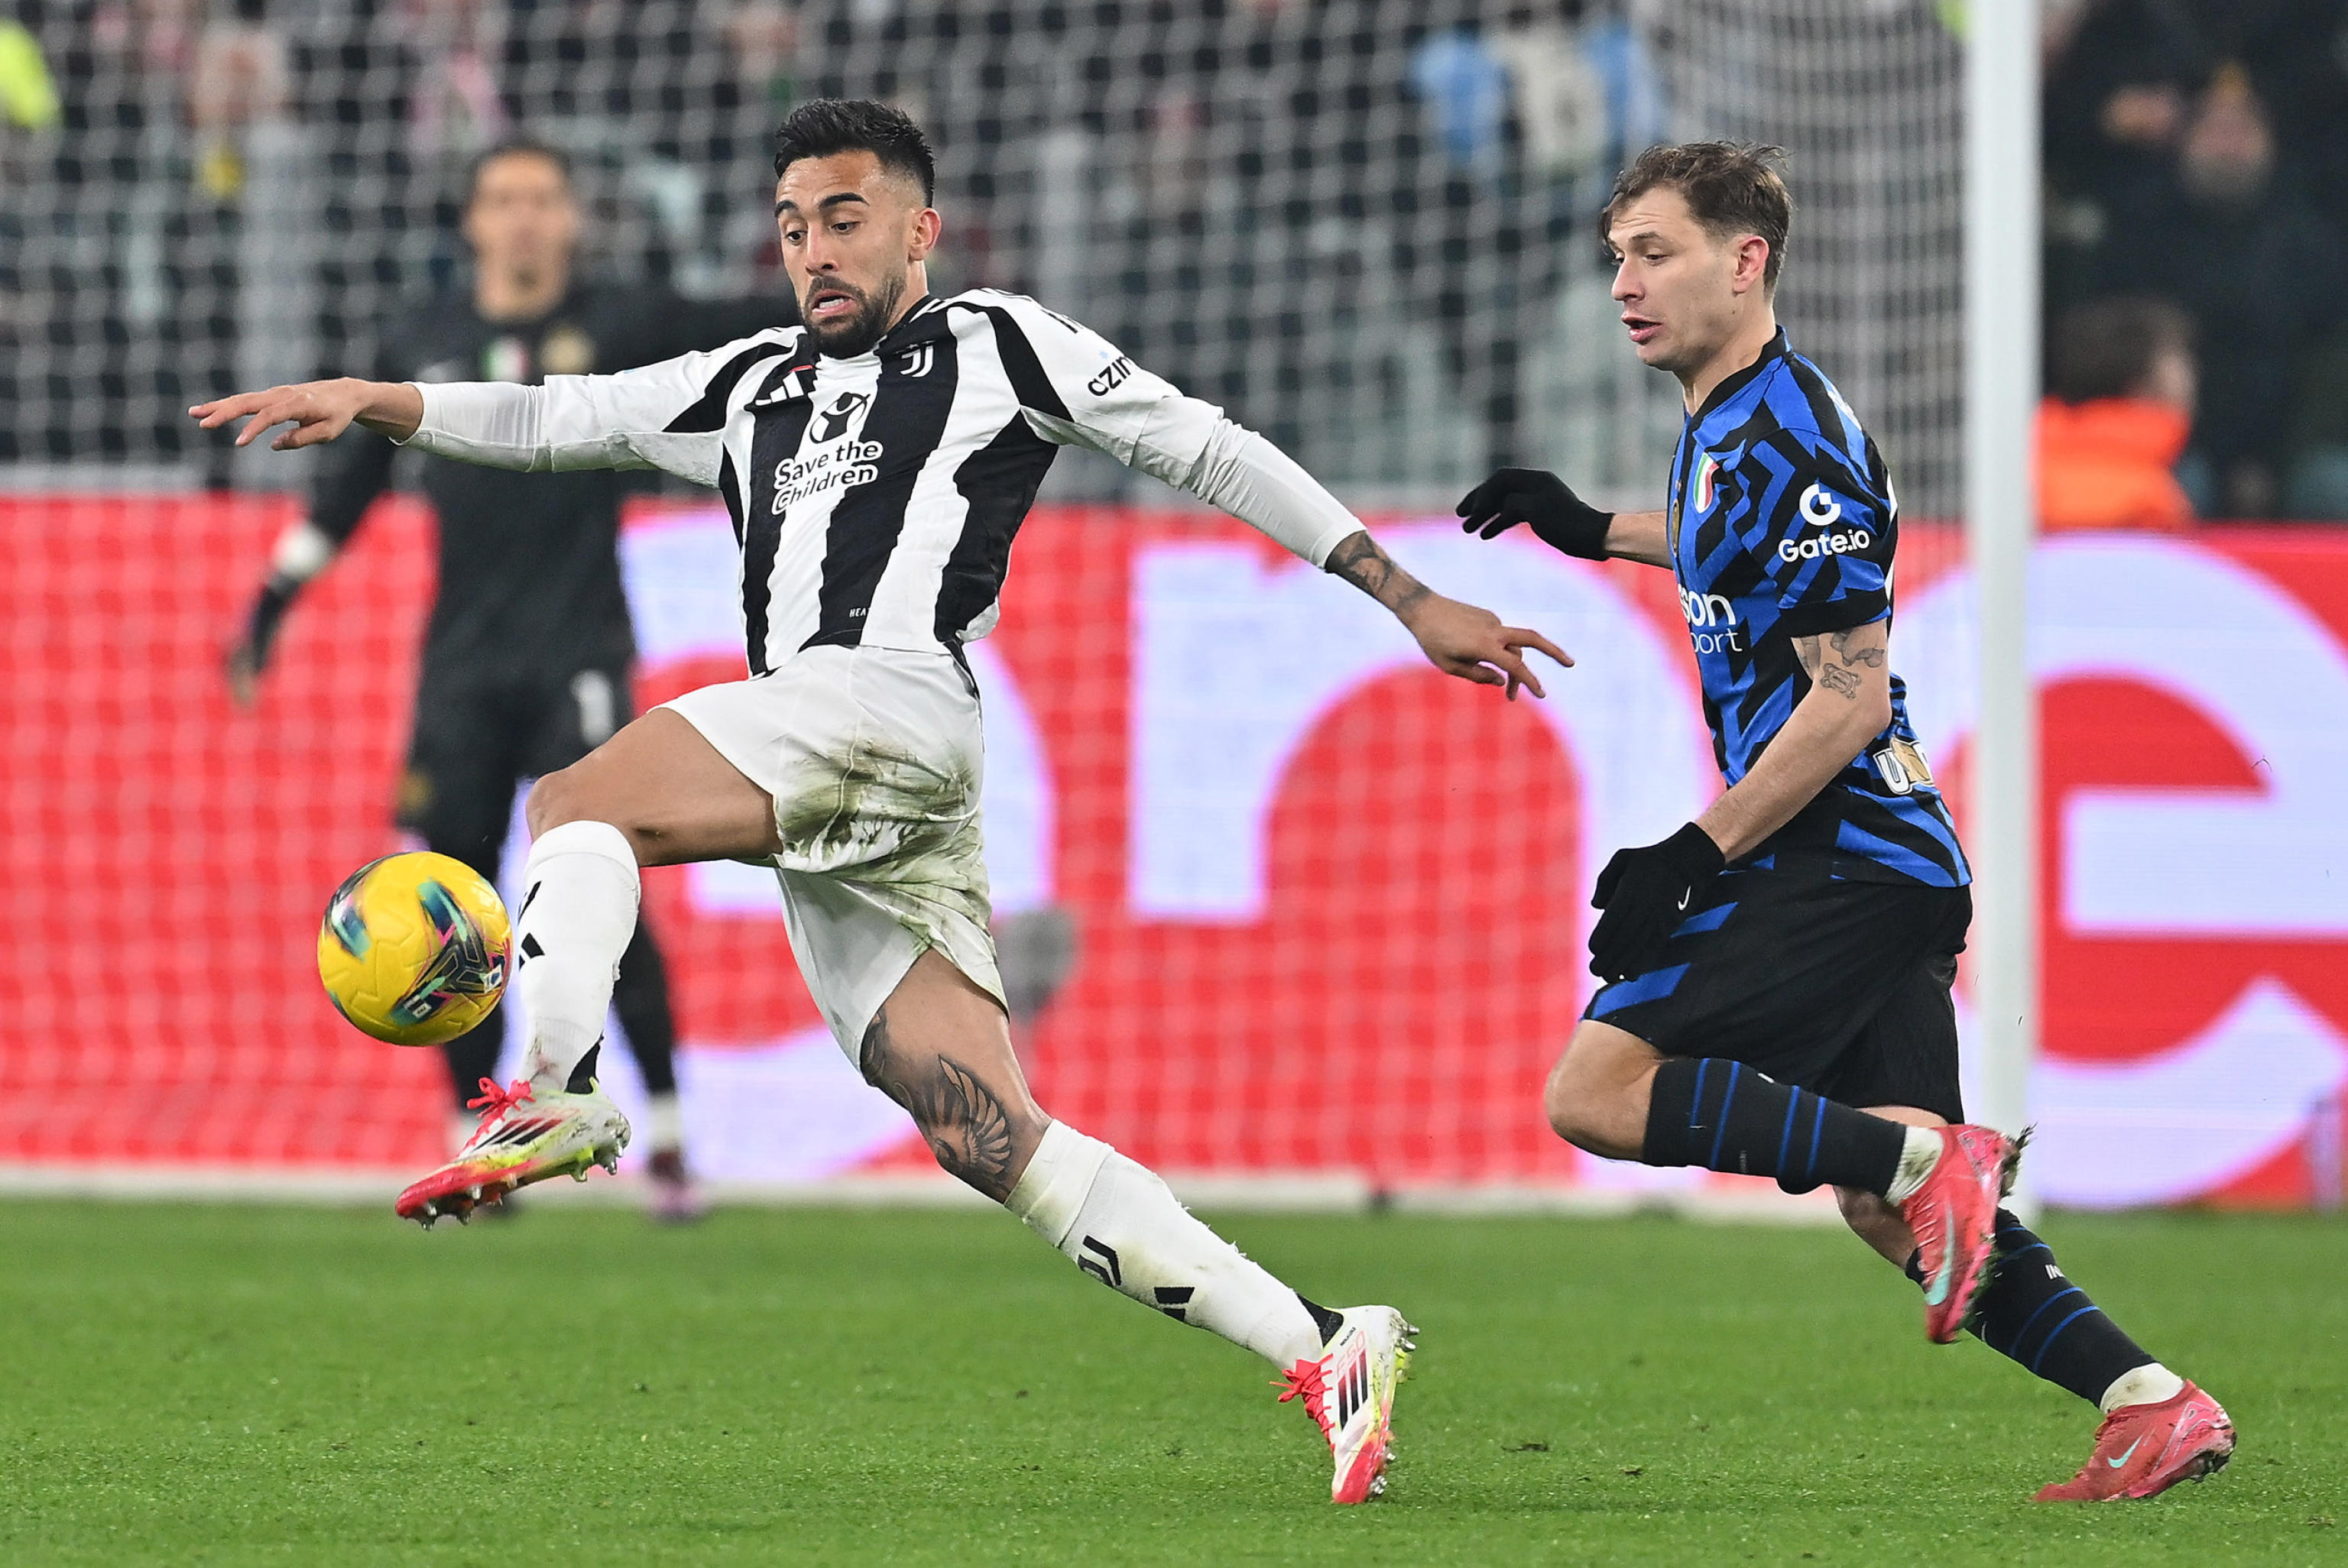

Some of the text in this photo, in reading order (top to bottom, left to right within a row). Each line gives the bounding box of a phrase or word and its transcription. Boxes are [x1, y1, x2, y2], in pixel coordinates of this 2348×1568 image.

[778, 441, 879, 485] Save the
[775, 468, 874, 512] Children
[1778, 529, 1870, 562] Gate.io
